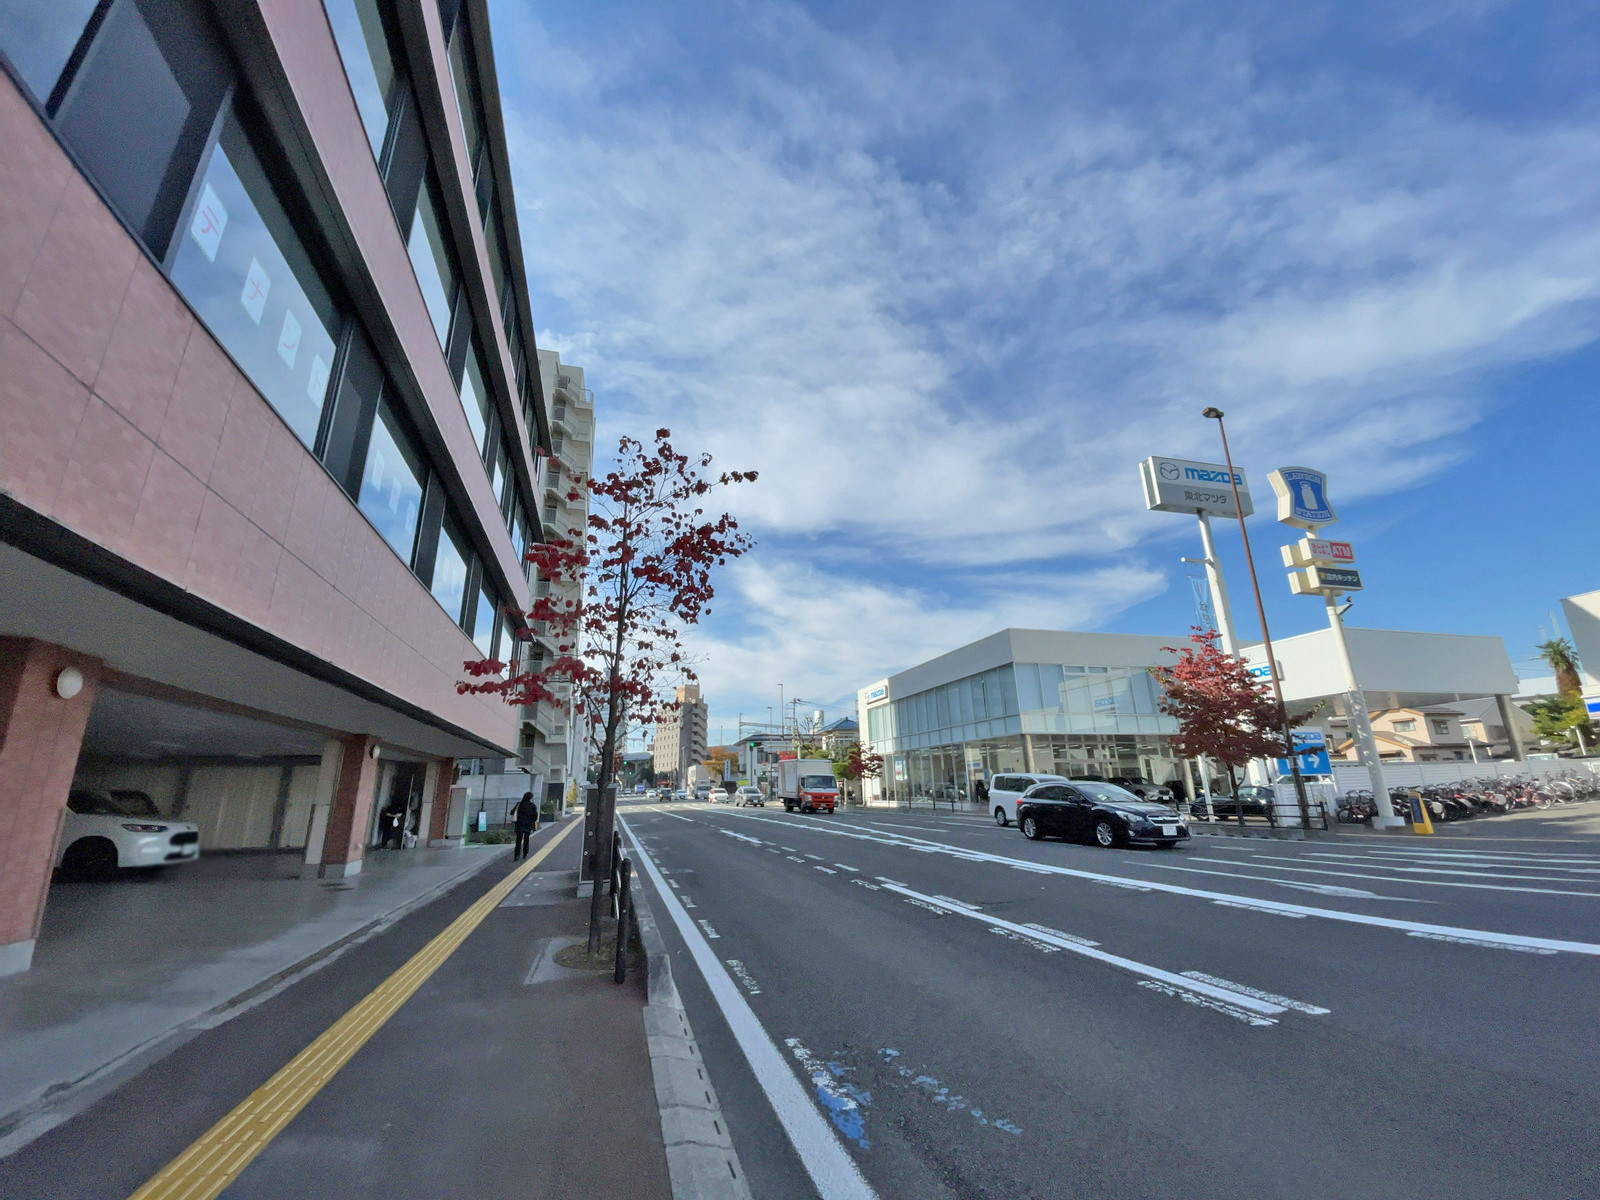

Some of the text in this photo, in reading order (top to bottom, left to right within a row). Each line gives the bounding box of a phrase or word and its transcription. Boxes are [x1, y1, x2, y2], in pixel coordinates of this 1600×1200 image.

[1184, 467, 1243, 486] mazda
[1286, 472, 1321, 484] LAWSON
[1295, 507, 1331, 518] STATION
[1332, 545, 1352, 557] ATM
